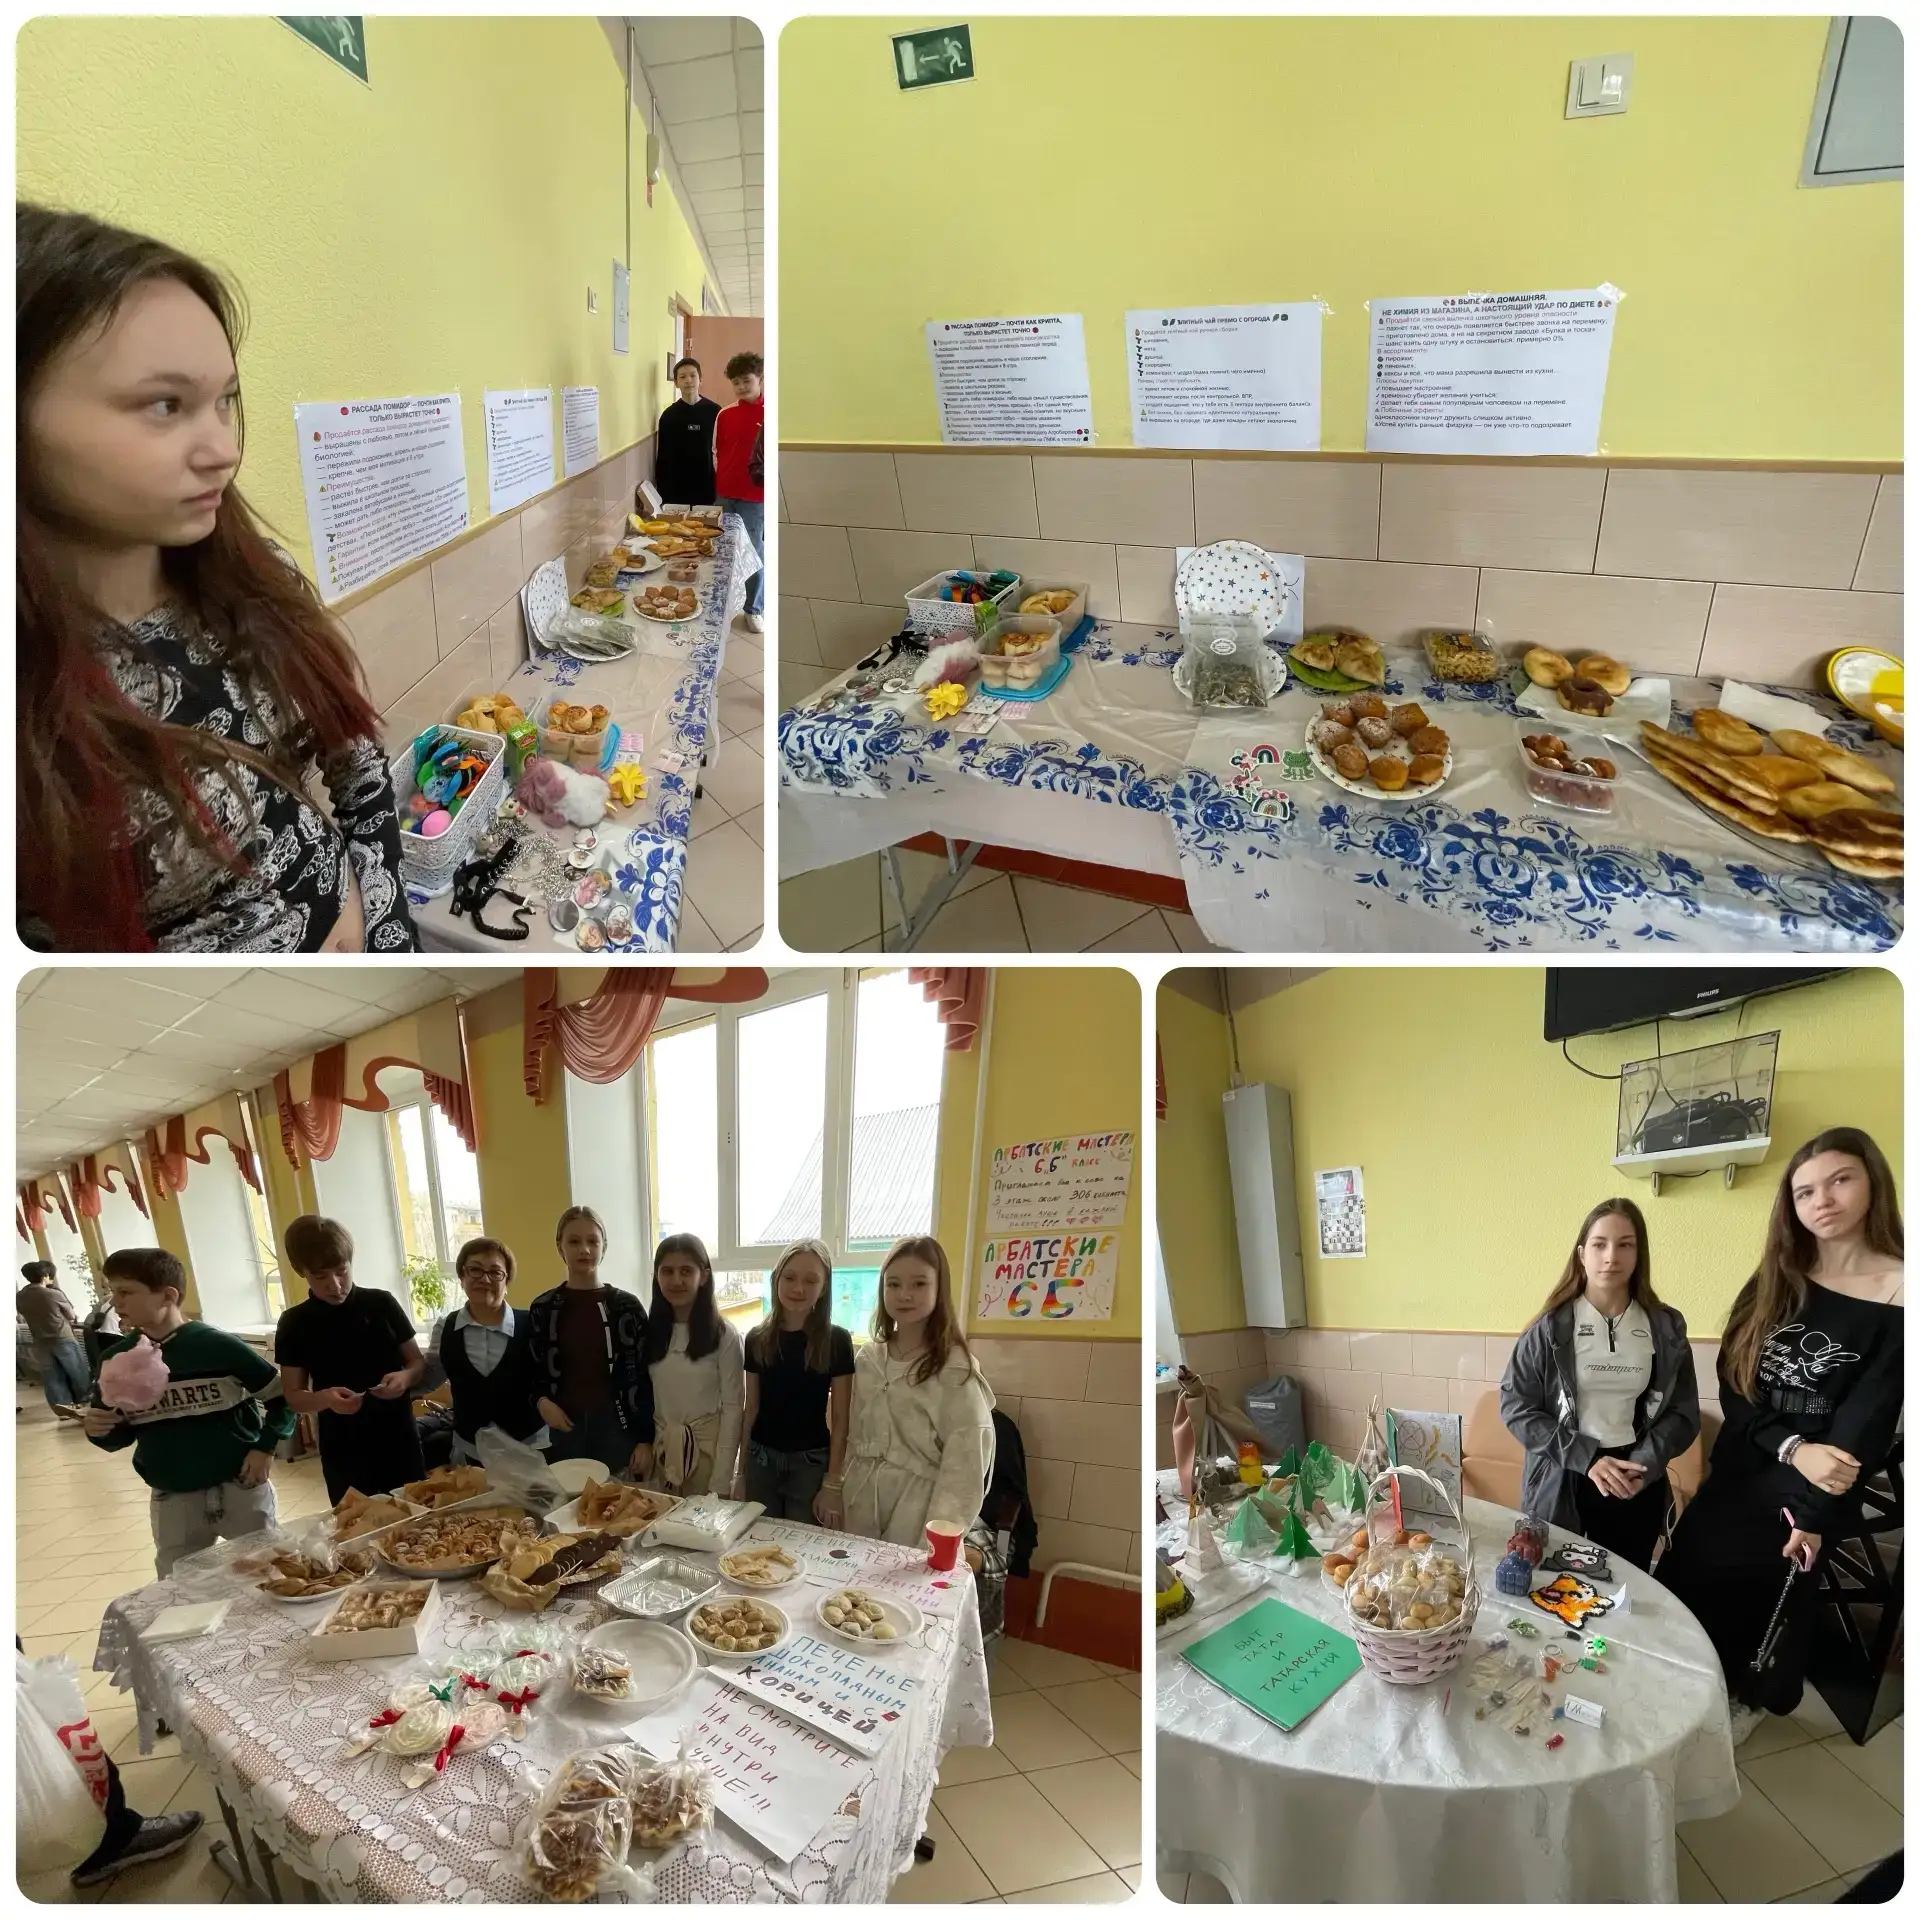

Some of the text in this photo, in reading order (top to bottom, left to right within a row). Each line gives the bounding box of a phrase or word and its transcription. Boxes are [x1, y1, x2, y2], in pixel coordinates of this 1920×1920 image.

[1481, 303, 1532, 312] НАСТОЯЩИЙ
[1534, 302, 1554, 310] УДАР
[351, 404, 381, 413] РАССАДА
[383, 401, 410, 410] ПОМИДОР
[368, 413, 393, 422] ТОЛЬКО
[1696, 988, 1720, 999] PHILIPS
[994, 1133, 1136, 1161] АРБАТСКИЕ МАСТЕРА
[1069, 1190, 1092, 1200] 306
[985, 1235, 1115, 1262] АРБАТСКИЕ
[995, 1258, 1095, 1280] МАСТЕРА
[770, 1526, 856, 1549] ПЕЧЕНЬЕ
[1234, 1628, 1264, 1651] БЫТ
[1241, 1632, 1284, 1662] ТАТАР
[792, 1636, 915, 1692] ПЕЧЕНЬЕ
[1260, 1638, 1331, 1692] ТАТАРСКАЯ
[1272, 1650, 1287, 1662] И
[1288, 1652, 1341, 1694] КУХНЯ
[738, 1665, 879, 1734] КОРИЦЕЙ
[702, 1702, 778, 1756] НА ВИД
[715, 1683, 859, 1769] НЕ СМОТРИТЕ
